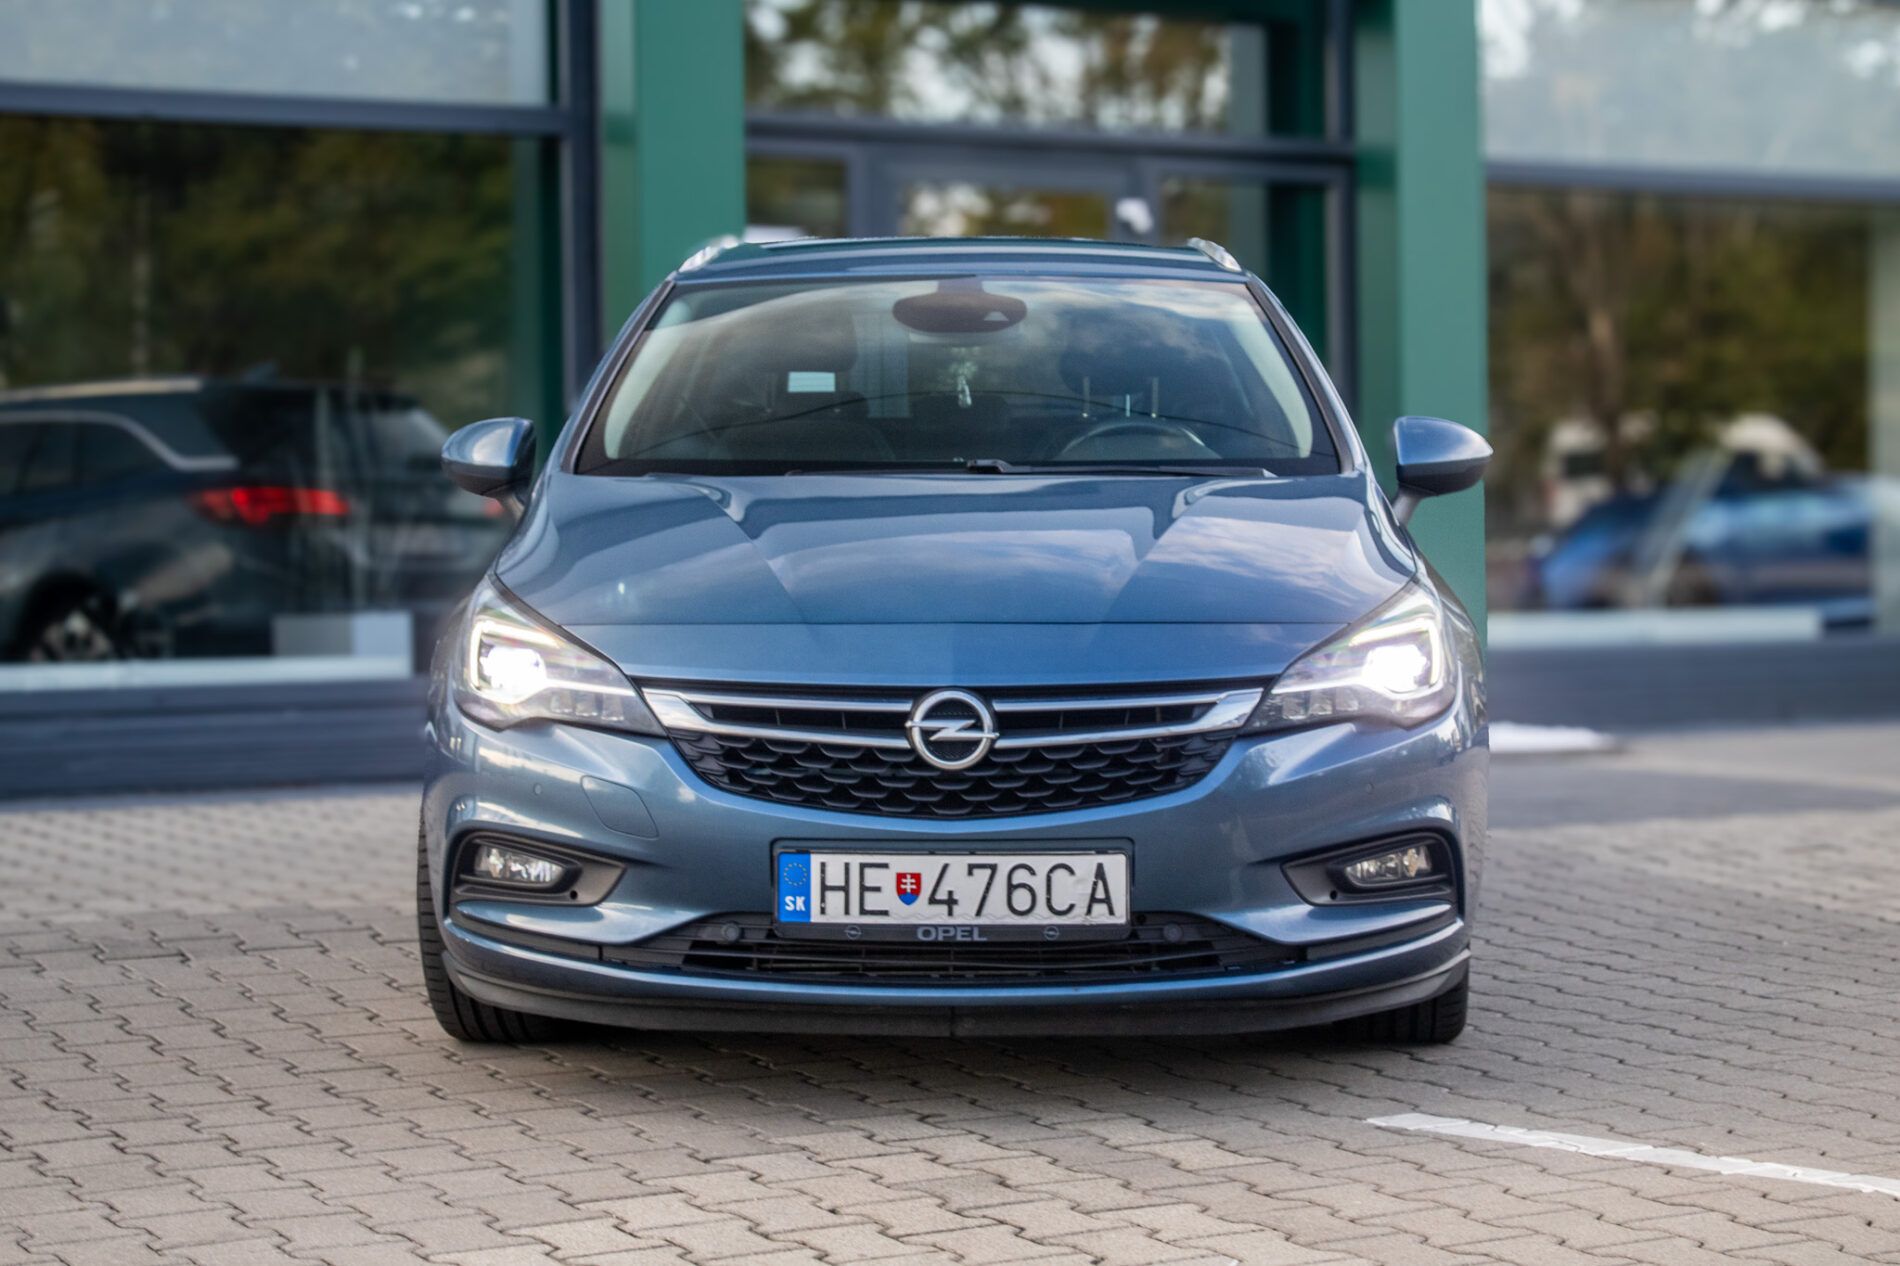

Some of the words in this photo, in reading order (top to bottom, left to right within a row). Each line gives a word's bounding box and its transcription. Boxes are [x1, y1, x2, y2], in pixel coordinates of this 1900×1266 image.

[820, 862, 890, 916] HE
[928, 863, 1116, 917] 476CA
[784, 896, 806, 912] SK
[917, 926, 988, 942] OPEL
